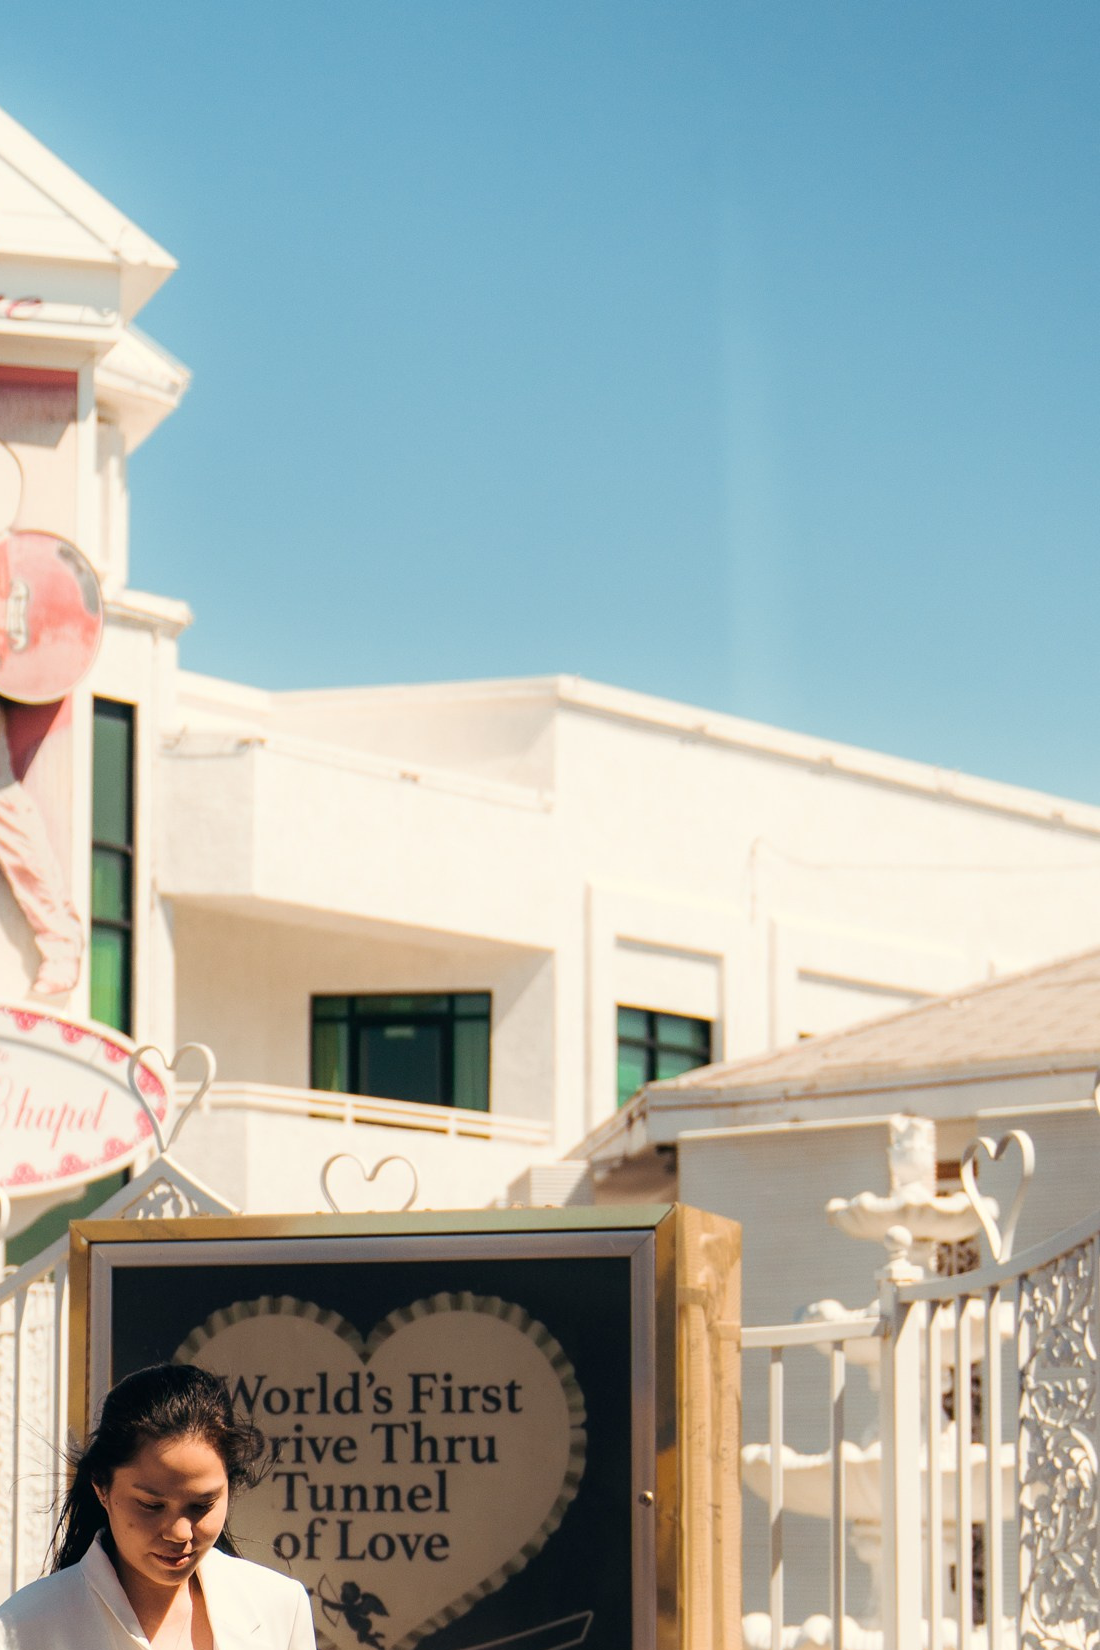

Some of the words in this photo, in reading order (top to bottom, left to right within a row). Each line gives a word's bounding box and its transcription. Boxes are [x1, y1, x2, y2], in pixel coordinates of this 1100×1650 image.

[408, 1371, 524, 1414] First
[371, 1421, 499, 1465] Thru
[272, 1471, 450, 1513] Tunnel
[273, 1517, 328, 1561] of
[335, 1520, 450, 1562] Love
